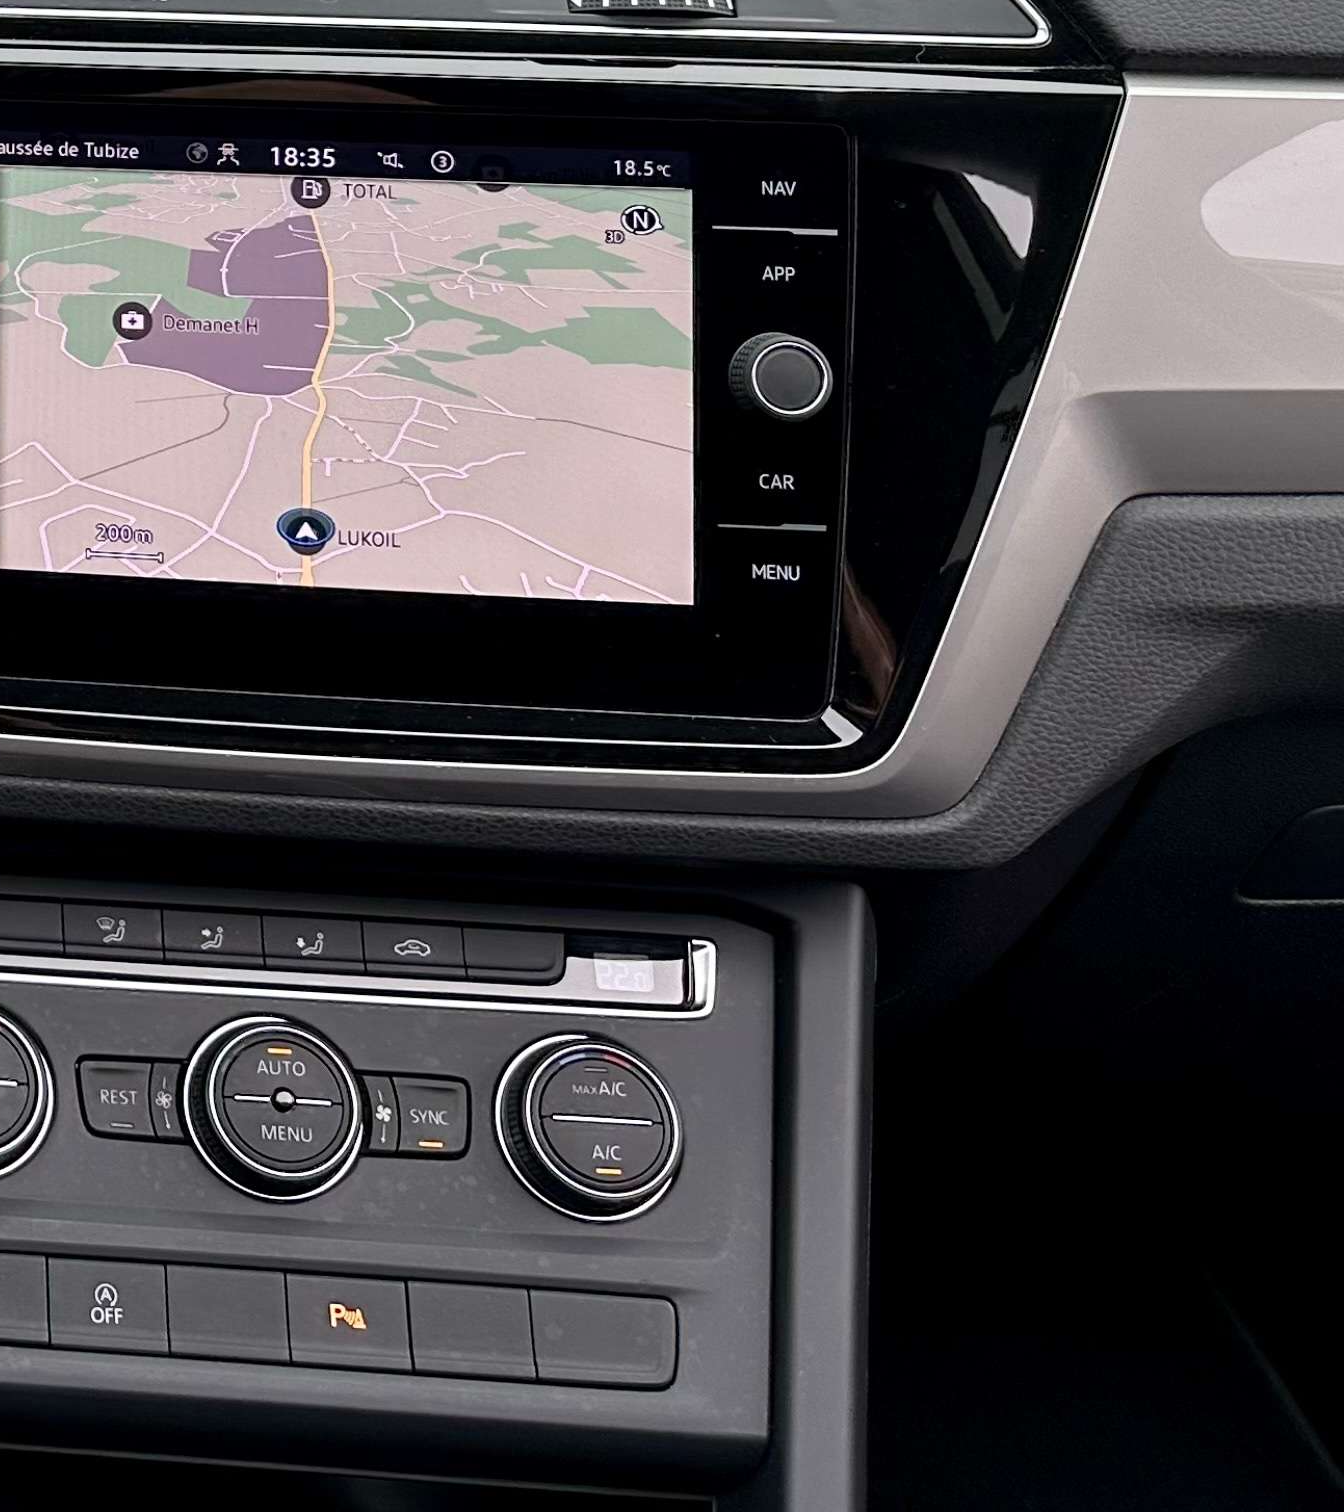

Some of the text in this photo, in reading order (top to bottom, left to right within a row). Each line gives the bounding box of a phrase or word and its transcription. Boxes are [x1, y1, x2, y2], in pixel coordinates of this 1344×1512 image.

[59, 142, 78, 156] de
[84, 142, 139, 158] Tubize
[271, 147, 335, 167] 18:35
[344, 180, 398, 199] TOTAL
[762, 181, 796, 195] NAV
[763, 266, 795, 281] APP
[162, 311, 259, 335] Demanet H
[760, 474, 794, 489] CAR
[96, 524, 153, 544] 200m
[338, 529, 401, 548] LUKOIL
[752, 564, 800, 581] MENU
[257, 1060, 305, 1076] AUTO
[101, 1089, 136, 1104] REST
[600, 1082, 626, 1096] A/C
[410, 1109, 447, 1125] SYNC
[262, 1125, 312, 1142] MENU
[593, 1145, 621, 1160] A/C
[91, 1305, 122, 1324] OFF
